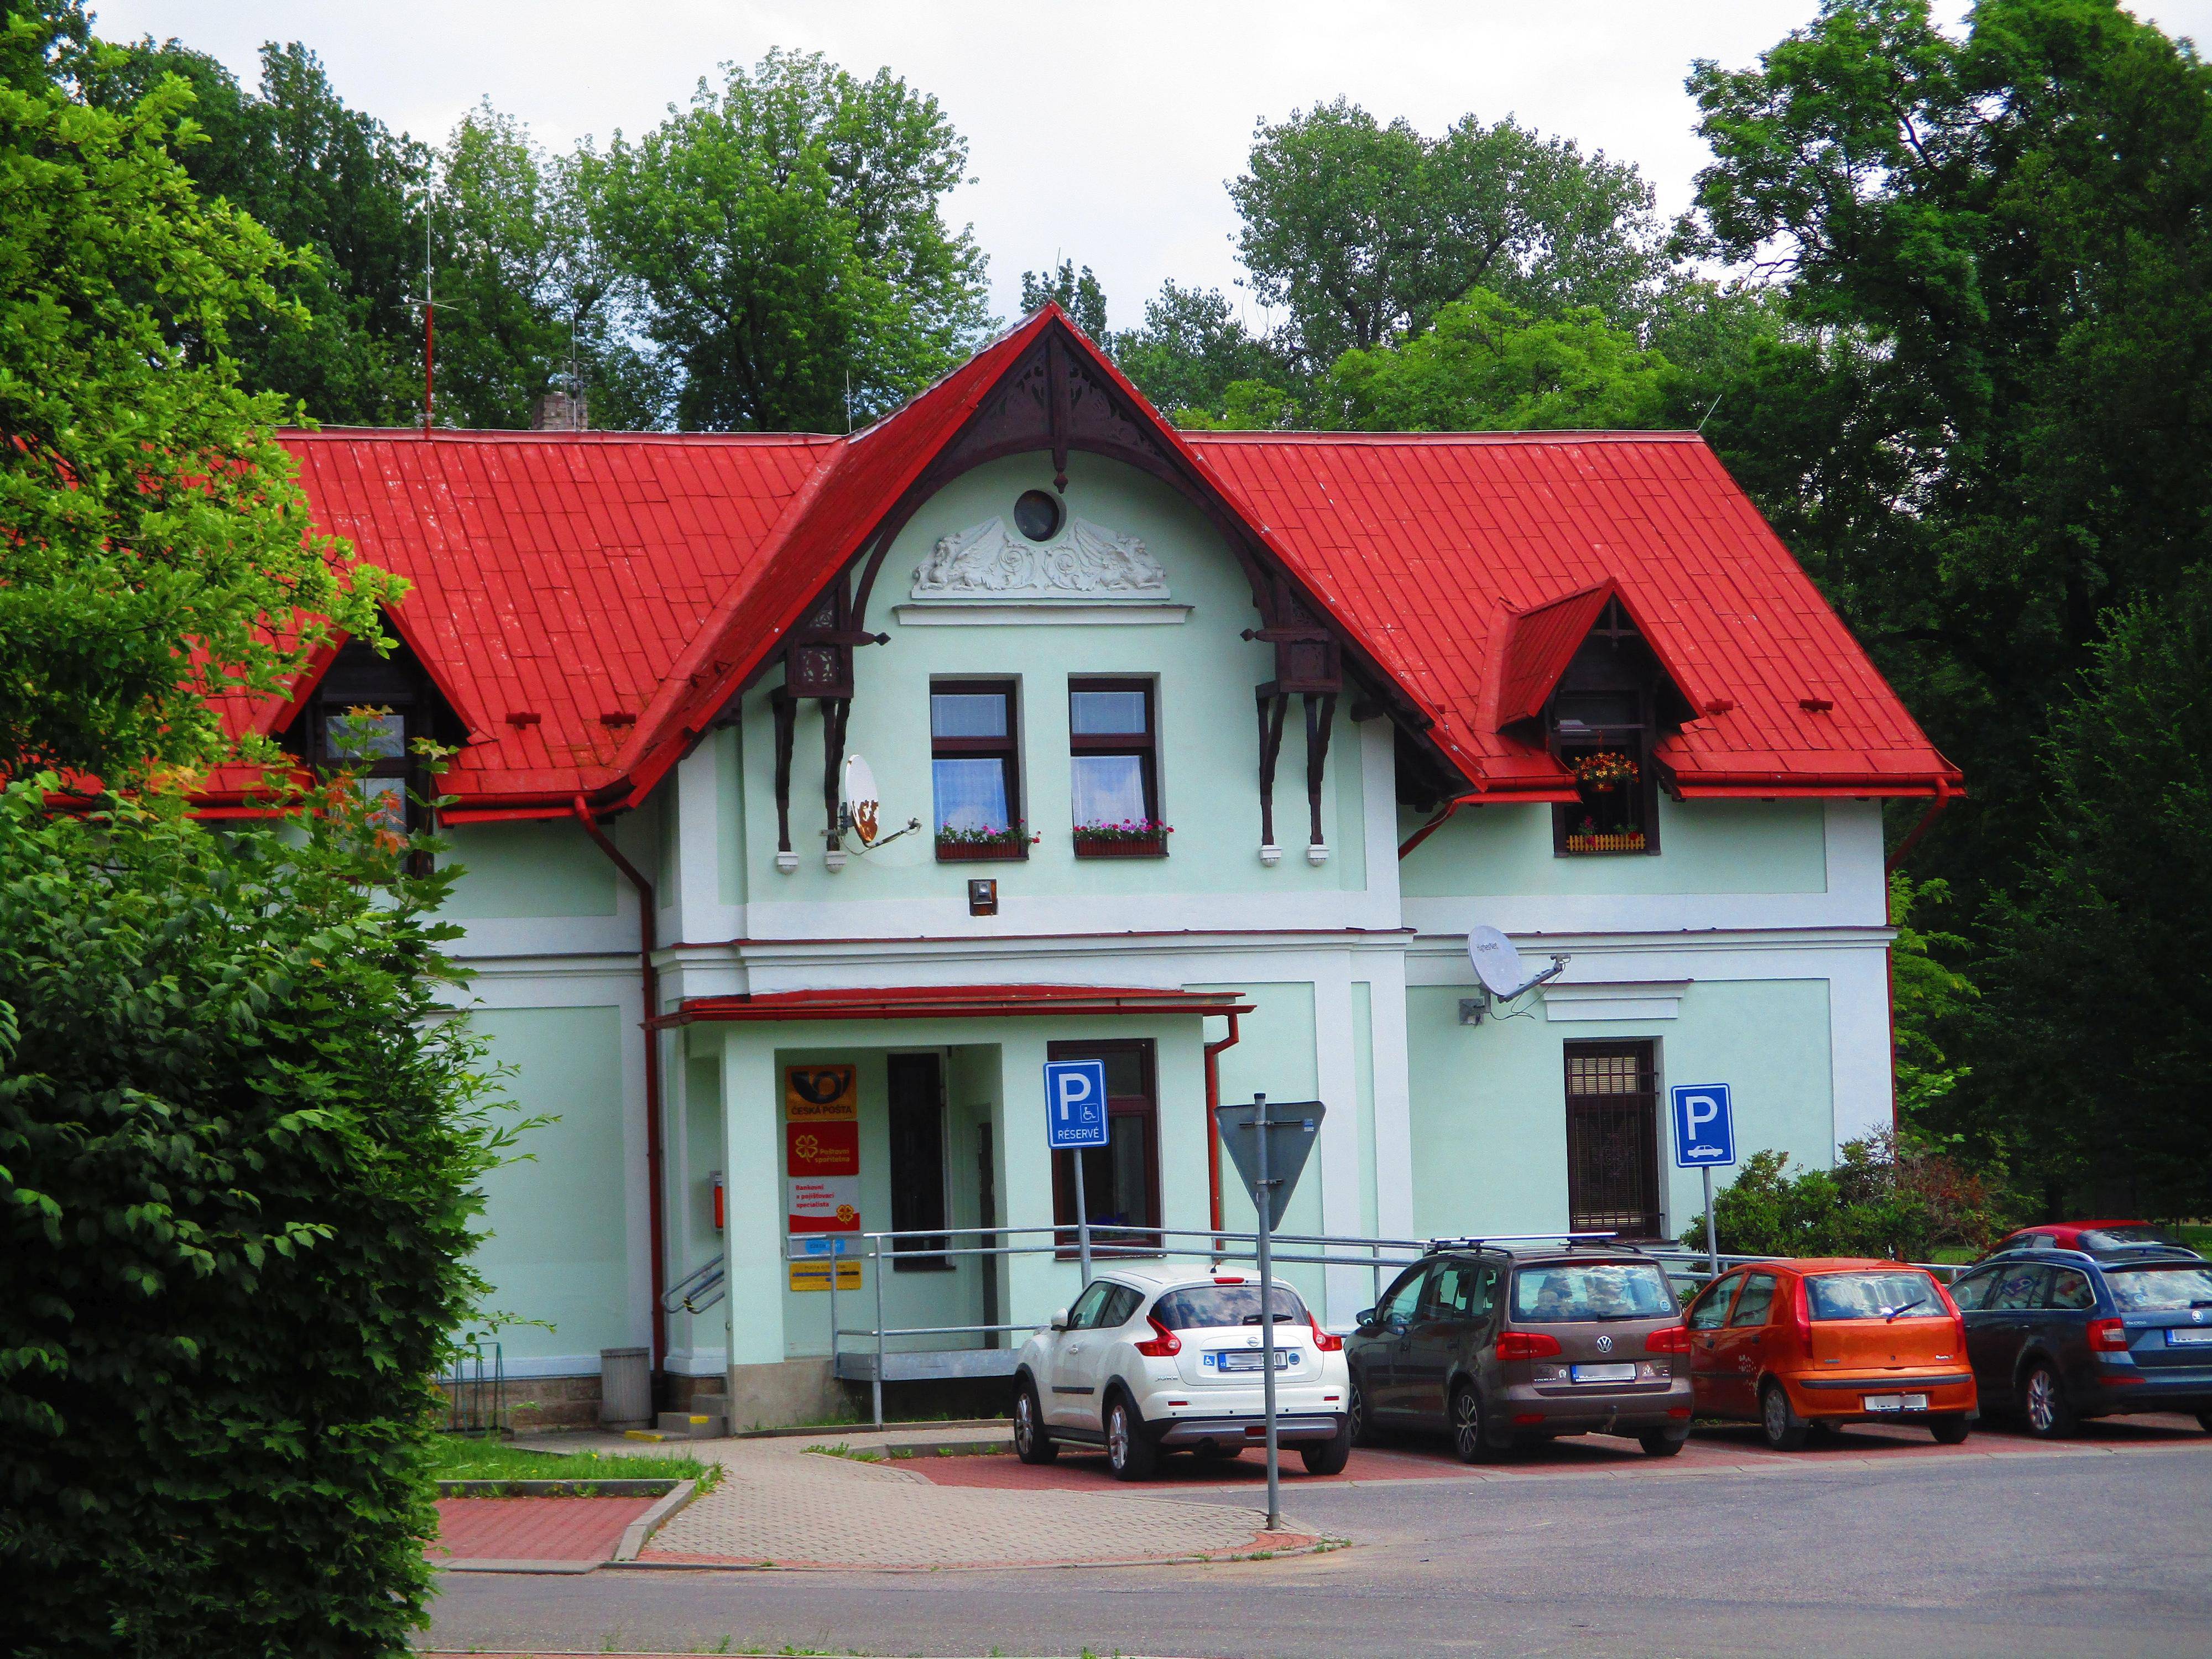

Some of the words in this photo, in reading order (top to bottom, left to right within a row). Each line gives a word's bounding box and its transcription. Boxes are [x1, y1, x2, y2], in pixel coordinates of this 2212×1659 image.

[822, 1104, 852, 1114] POŠTA
[1058, 1073, 1091, 1120] P
[1686, 1095, 1718, 1140] P
[1058, 1126, 1099, 1140] RÉSERVÉ
